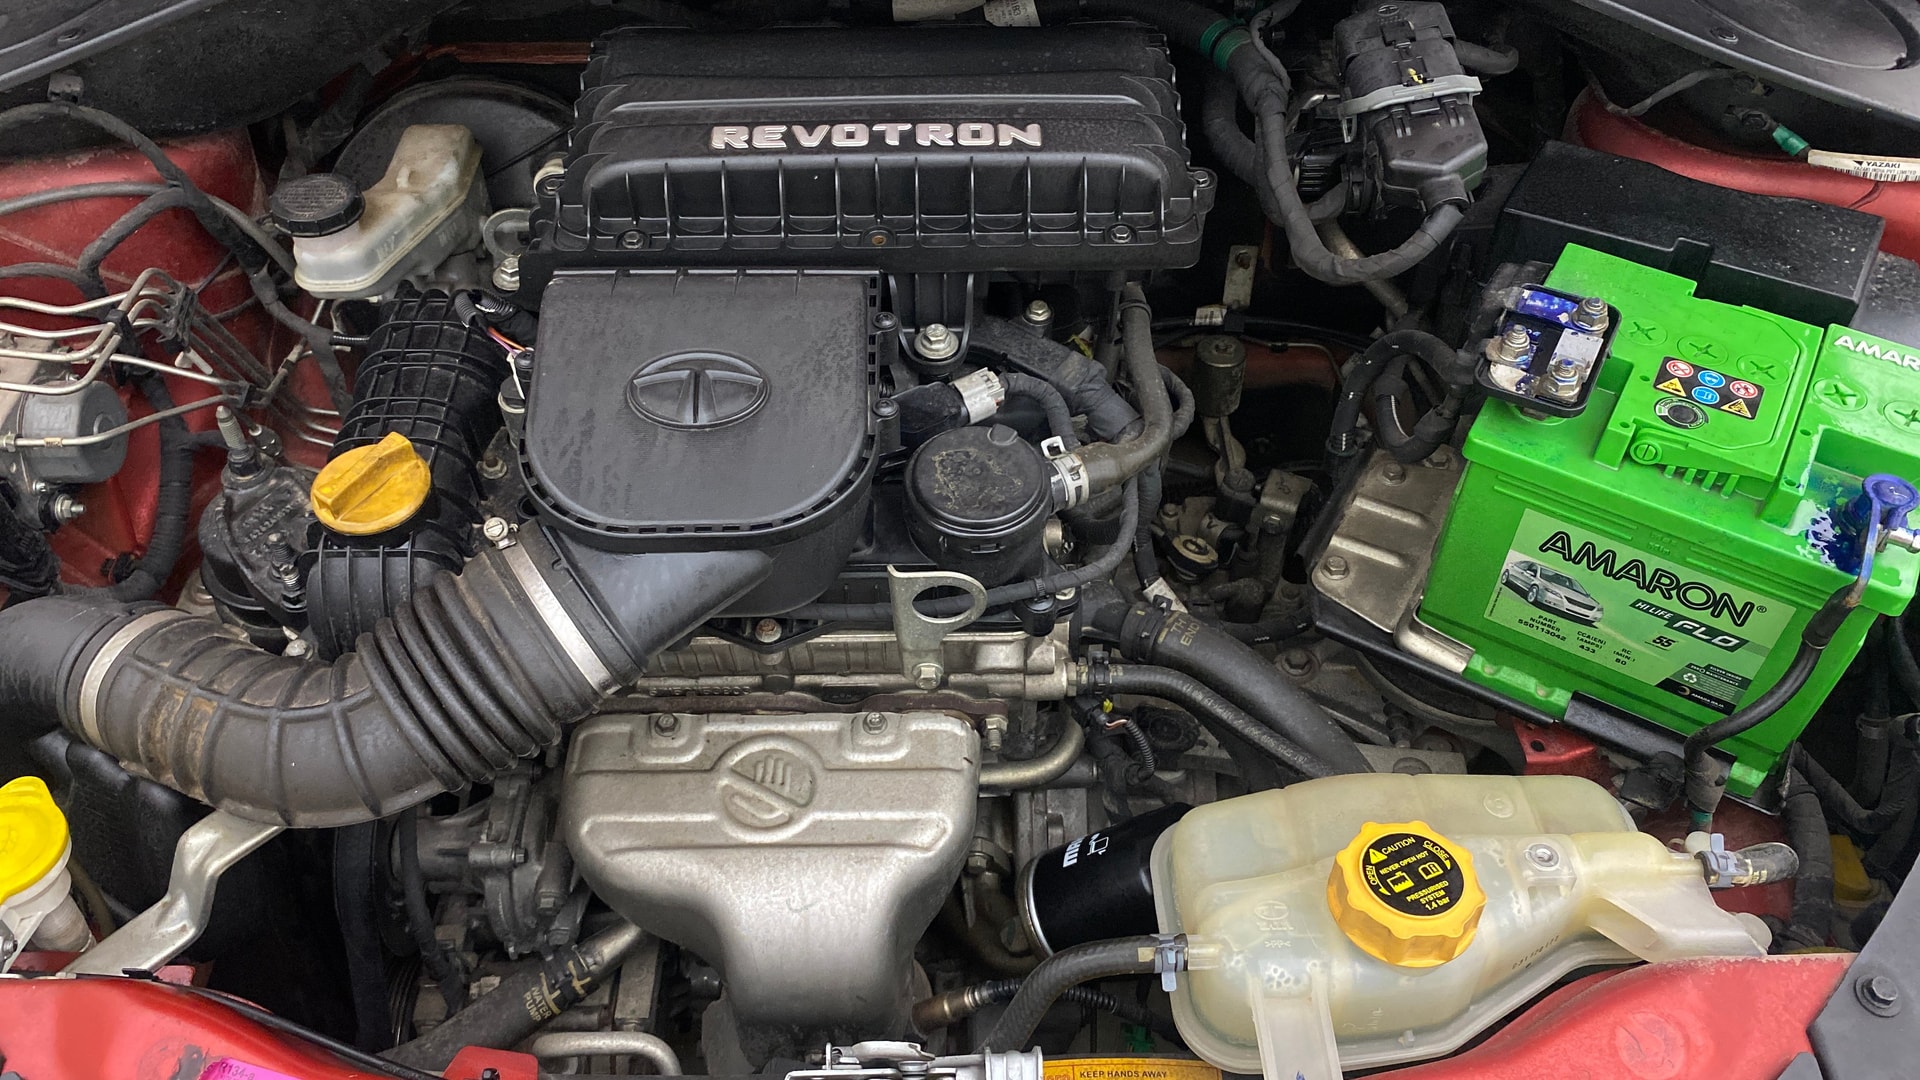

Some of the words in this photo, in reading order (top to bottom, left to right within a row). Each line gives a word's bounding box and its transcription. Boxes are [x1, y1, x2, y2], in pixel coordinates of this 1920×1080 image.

[711, 123, 1042, 149] REVOTRON
[1538, 615, 1557, 625] PART
[1636, 602, 1649, 611] HI
[1649, 605, 1674, 620] LIFE
[1529, 617, 1561, 632] NUMBER
[1180, 622, 1201, 647] END
[1652, 635, 1677, 649] 55
[1673, 620, 1740, 649] FLO
[1381, 836, 1416, 855] CAUTION
[1422, 840, 1450, 861] CLOSE
[1380, 862, 1401, 875] NEVER
[1400, 854, 1416, 867] OPEN
[1415, 850, 1429, 860] HOT
[1365, 864, 1377, 886] OPEN
[1406, 880, 1449, 902] PRESSURISED
[1420, 889, 1446, 905] SYSTEM
[1437, 896, 1450, 907] bar
[1079, 1070, 1104, 1078] KEEP
[1142, 1071, 1167, 1079] AWAY
